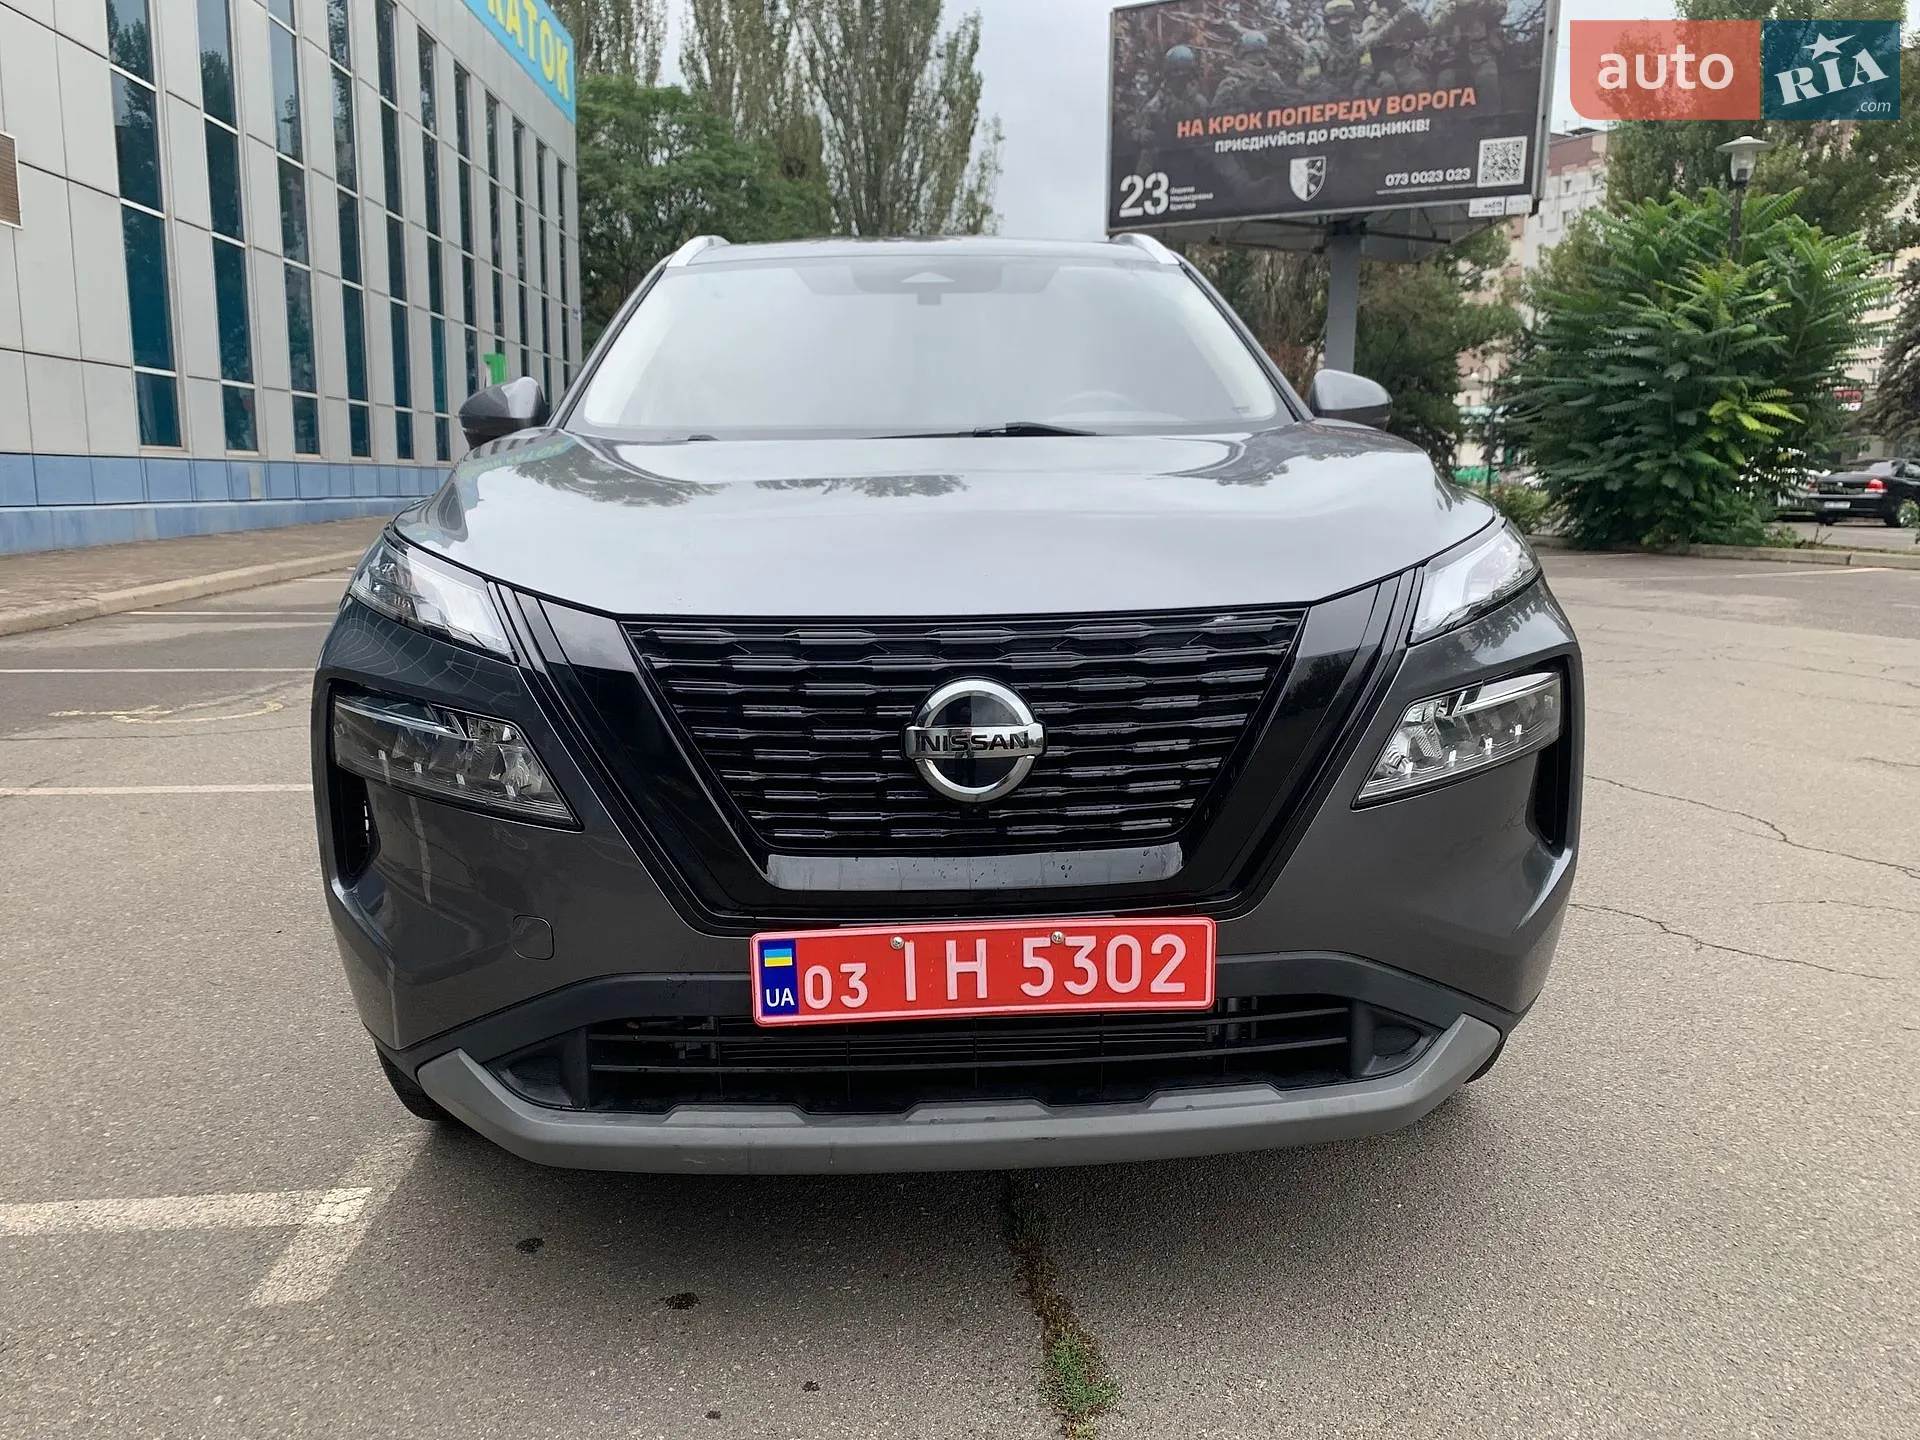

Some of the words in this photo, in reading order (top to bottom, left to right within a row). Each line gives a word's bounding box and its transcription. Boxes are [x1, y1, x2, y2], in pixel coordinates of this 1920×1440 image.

[1177, 118, 1204, 138] НА
[1208, 112, 1262, 135] КРОК
[1267, 97, 1381, 128] ПОПЕРЕДУ
[1386, 87, 1476, 115] ВОРОГА
[1215, 129, 1305, 153] ПРИЄДНУЙСЯ
[1306, 128, 1328, 145] ДО
[1330, 118, 1431, 140] РОЗВІДНИКІВ!
[1119, 172, 1169, 217] 23
[1385, 172, 1409, 187] 073
[1410, 169, 1444, 184] 0023
[1445, 167, 1471, 182] 023
[920, 732, 1029, 752] NISSAN
[803, 962, 869, 1009] 03
[1020, 934, 1187, 997] 5302
[765, 988, 795, 1007] UA
